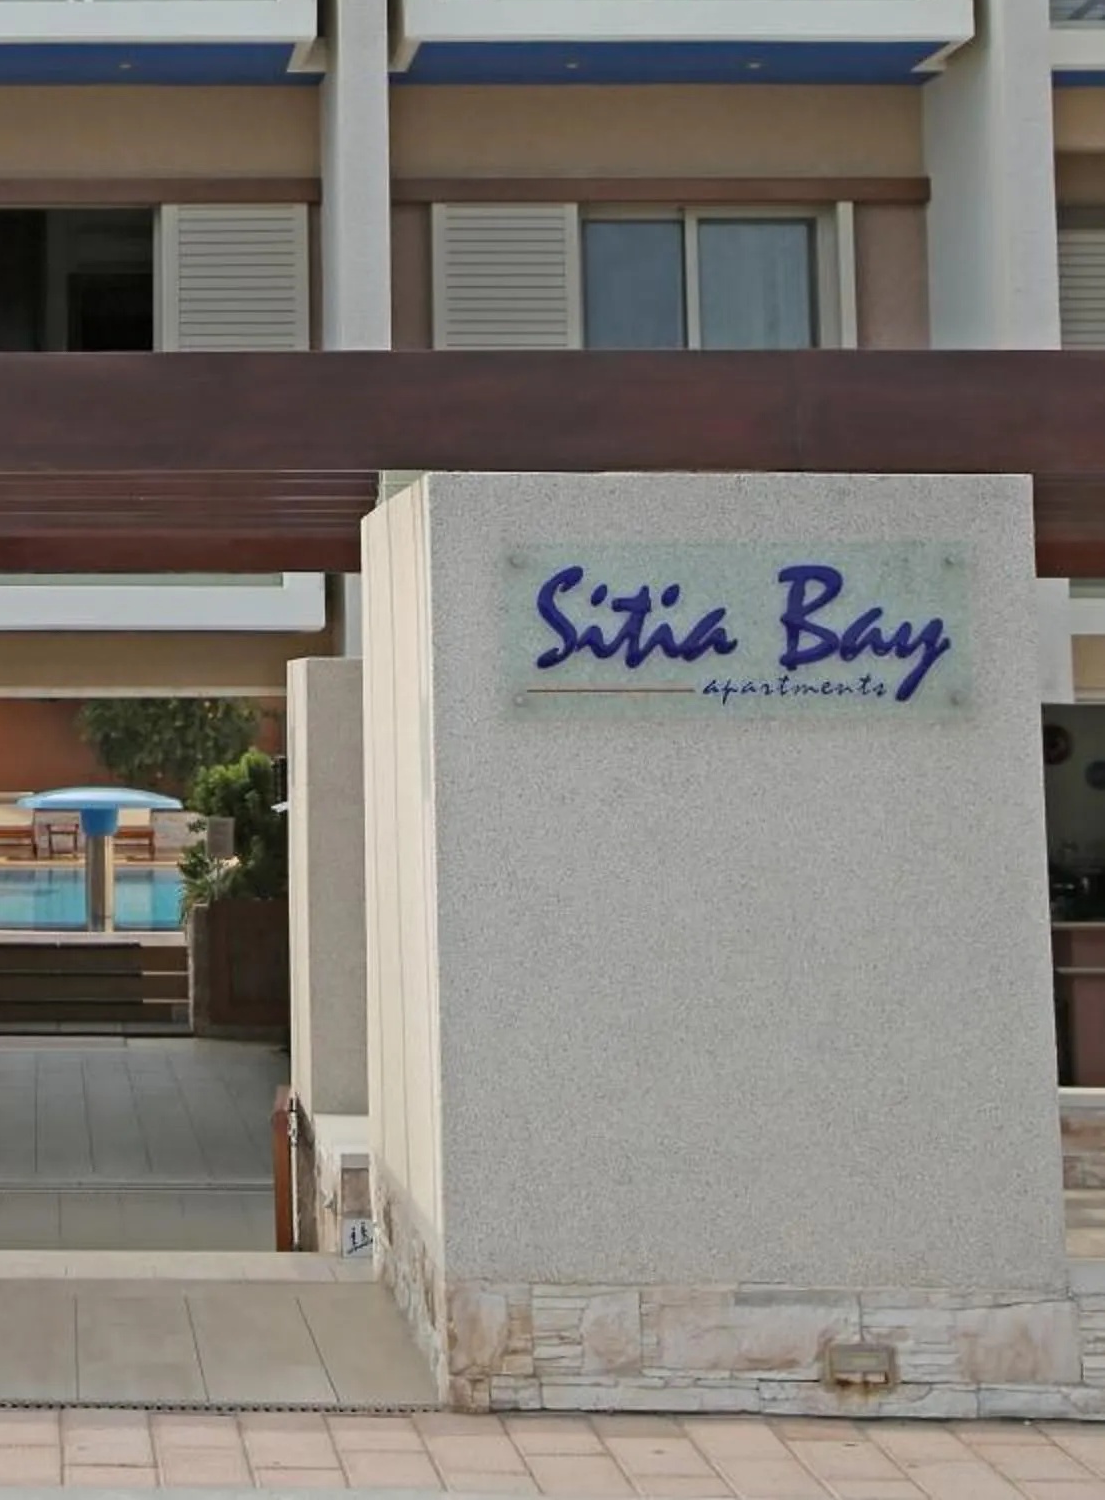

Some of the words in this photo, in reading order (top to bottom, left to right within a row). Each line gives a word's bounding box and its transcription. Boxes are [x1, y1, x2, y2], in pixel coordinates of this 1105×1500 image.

[535, 565, 739, 670] Sitia
[777, 564, 952, 703] Bay
[702, 672, 888, 706] apartments
